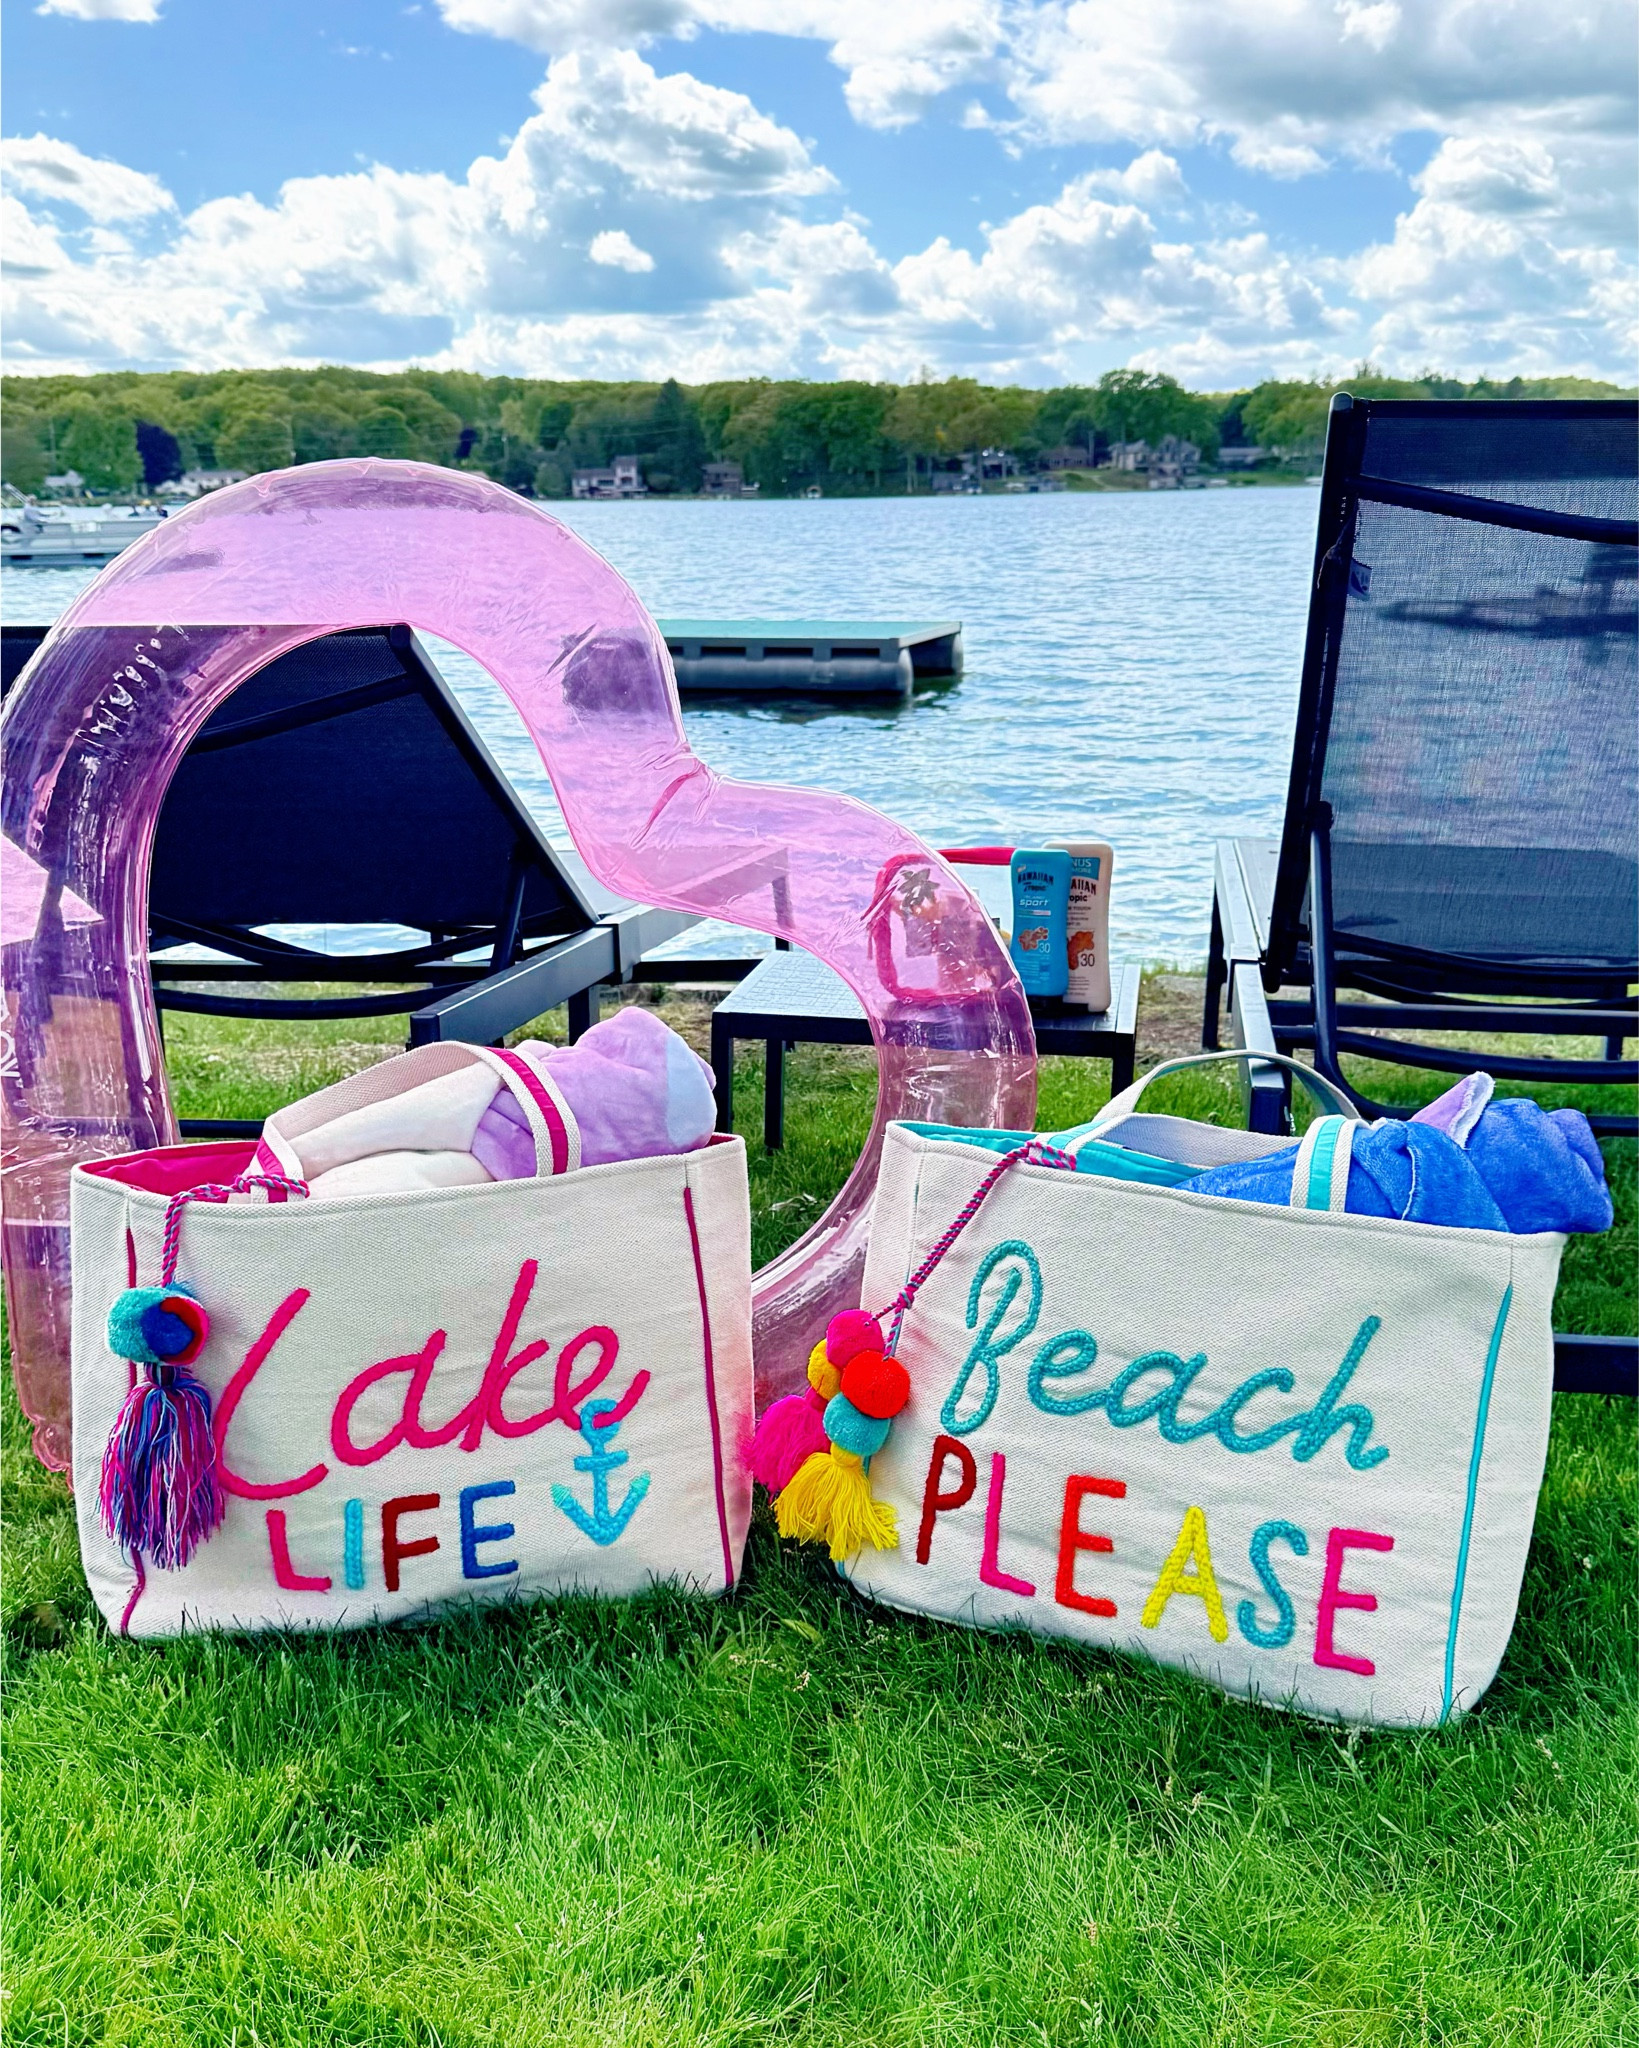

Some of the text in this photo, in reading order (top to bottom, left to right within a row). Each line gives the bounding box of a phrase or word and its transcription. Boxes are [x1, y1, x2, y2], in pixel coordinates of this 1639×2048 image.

[1072, 858, 1092, 868] NUS
[1017, 872, 1054, 886] HAWAIIAN
[1070, 878, 1097, 896] AIIAN
[1019, 899, 1049, 907] sport
[1069, 891, 1088, 903] opic
[1039, 943, 1050, 953] 30
[1080, 953, 1095, 967] 30
[940, 1239, 1390, 1470] Beach
[212, 1259, 651, 1499] Lake
[266, 1480, 519, 1593] LIFE
[916, 1435, 1395, 1676] PLEASE
